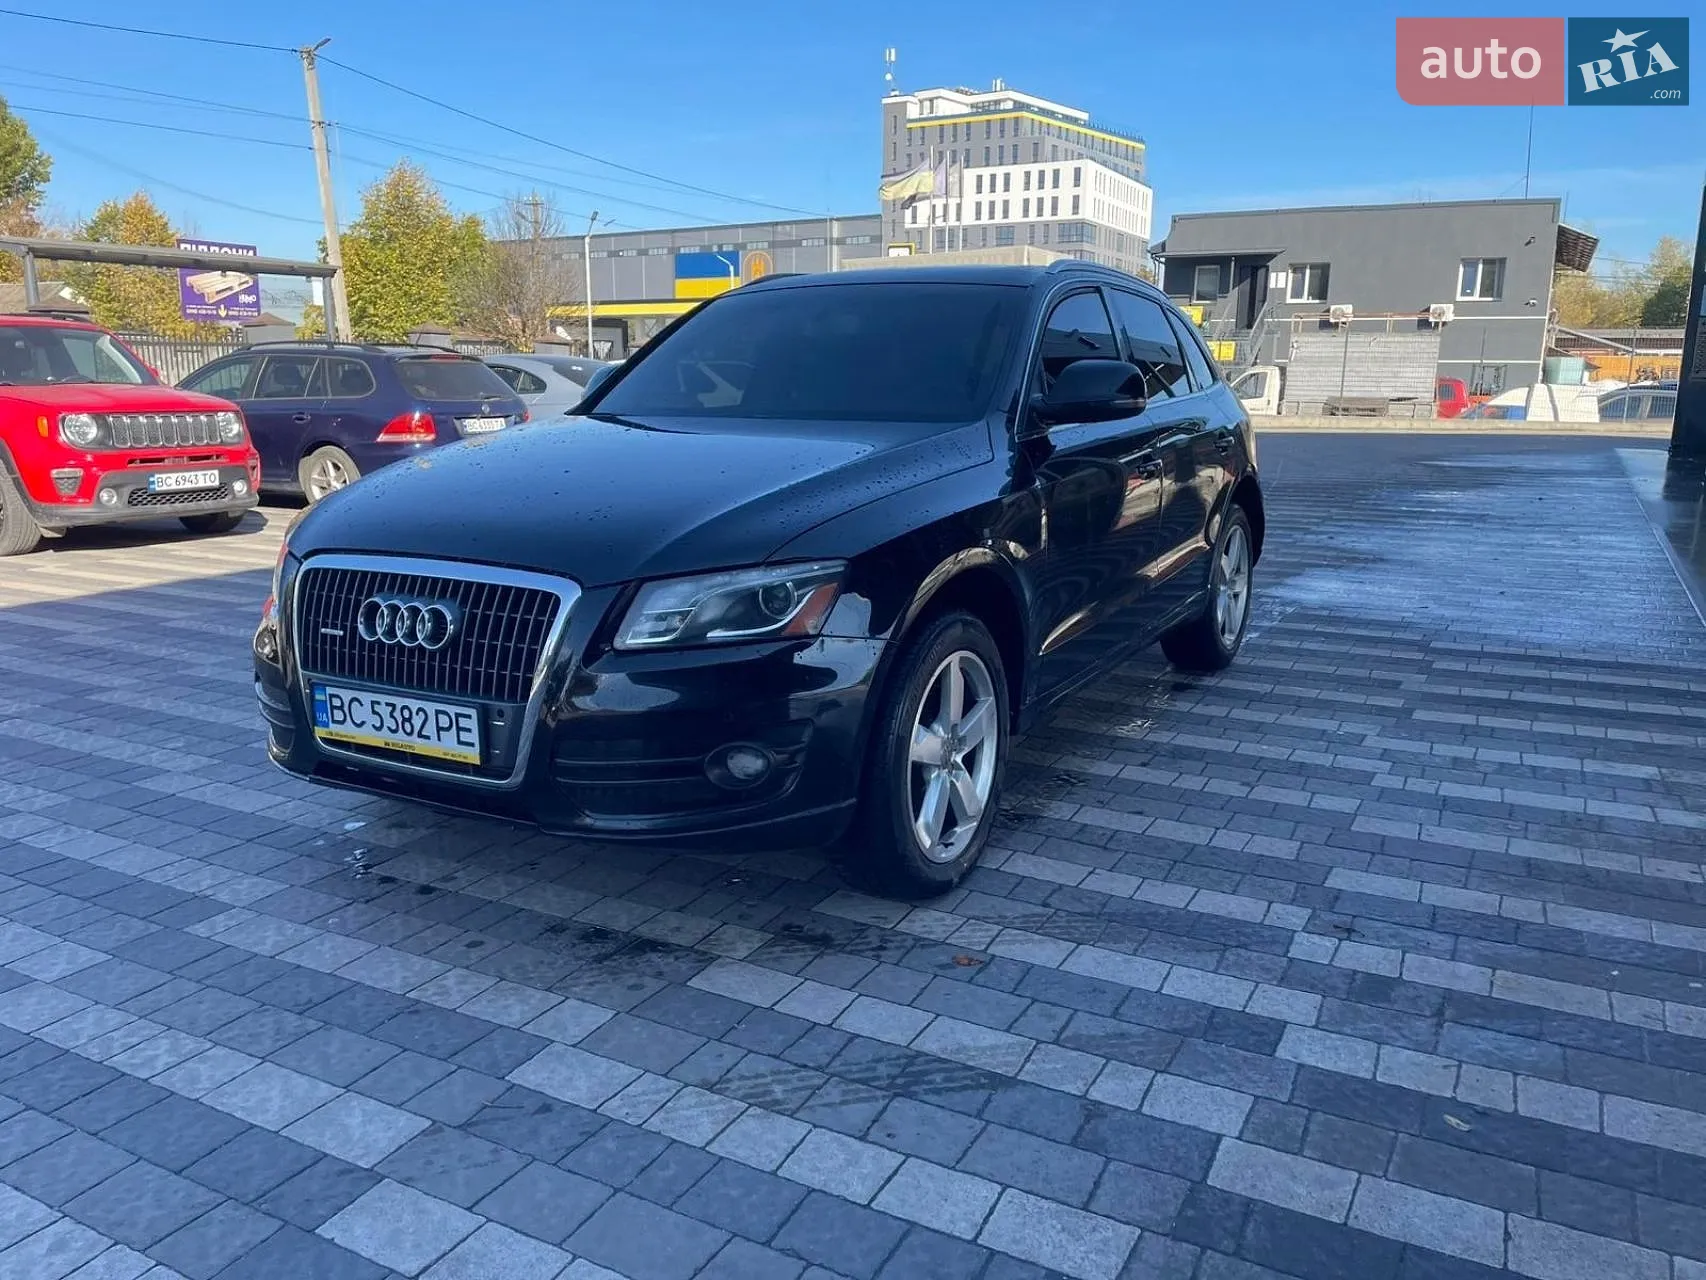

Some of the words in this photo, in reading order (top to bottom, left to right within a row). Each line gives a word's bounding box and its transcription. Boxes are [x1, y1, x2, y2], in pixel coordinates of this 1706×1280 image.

[157, 476, 172, 488] BC
[175, 473, 199, 486] 6943
[201, 472, 216, 484] TO
[328, 693, 366, 728] BC
[370, 700, 431, 740] 5382
[434, 709, 475, 748] PE
